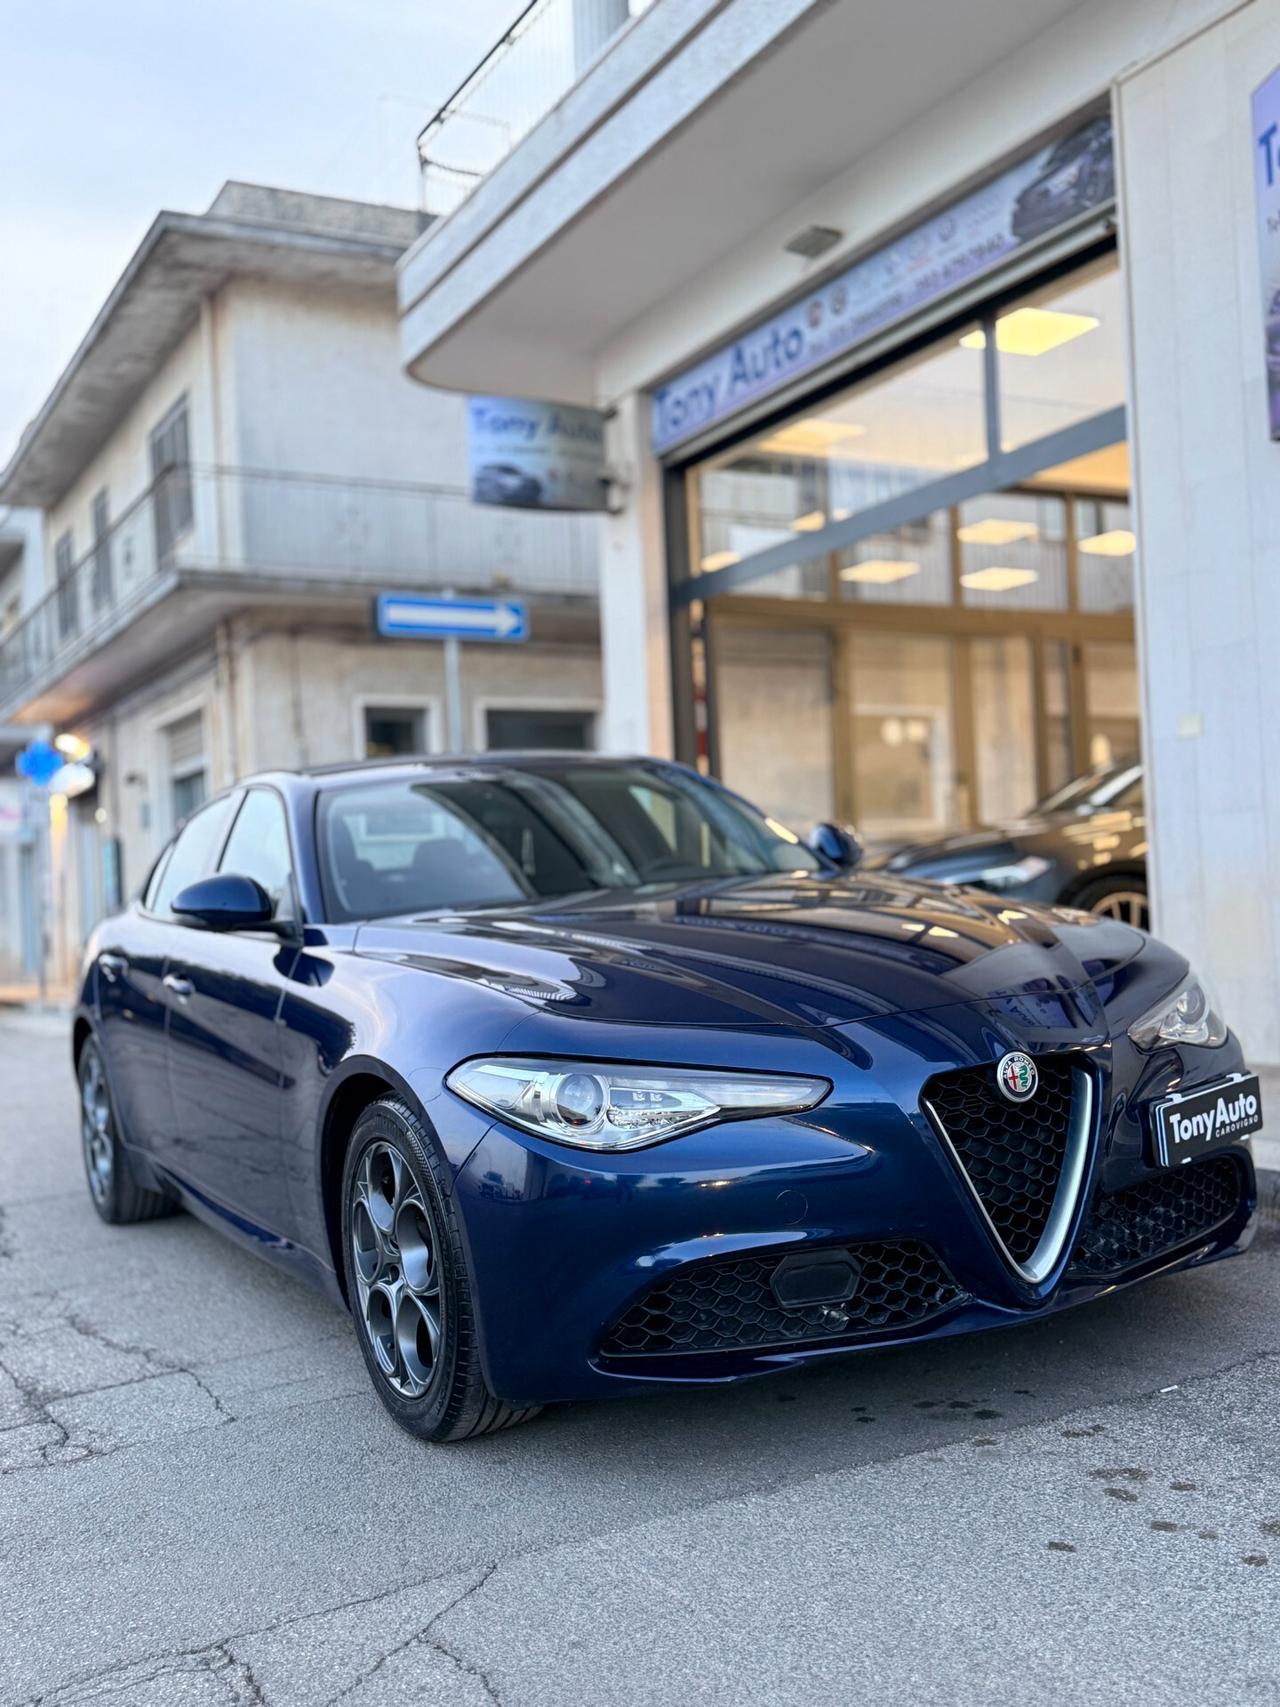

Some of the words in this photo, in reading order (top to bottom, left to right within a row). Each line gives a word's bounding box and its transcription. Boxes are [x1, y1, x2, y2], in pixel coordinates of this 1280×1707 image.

[1259, 120, 1280, 186] T
[655, 371, 722, 434] Tony
[727, 327, 804, 396] Auto
[474, 405, 540, 441] Tony
[1169, 1092, 1257, 1144] TonyAuto
[1215, 1114, 1258, 1138] CAROVIGNO
